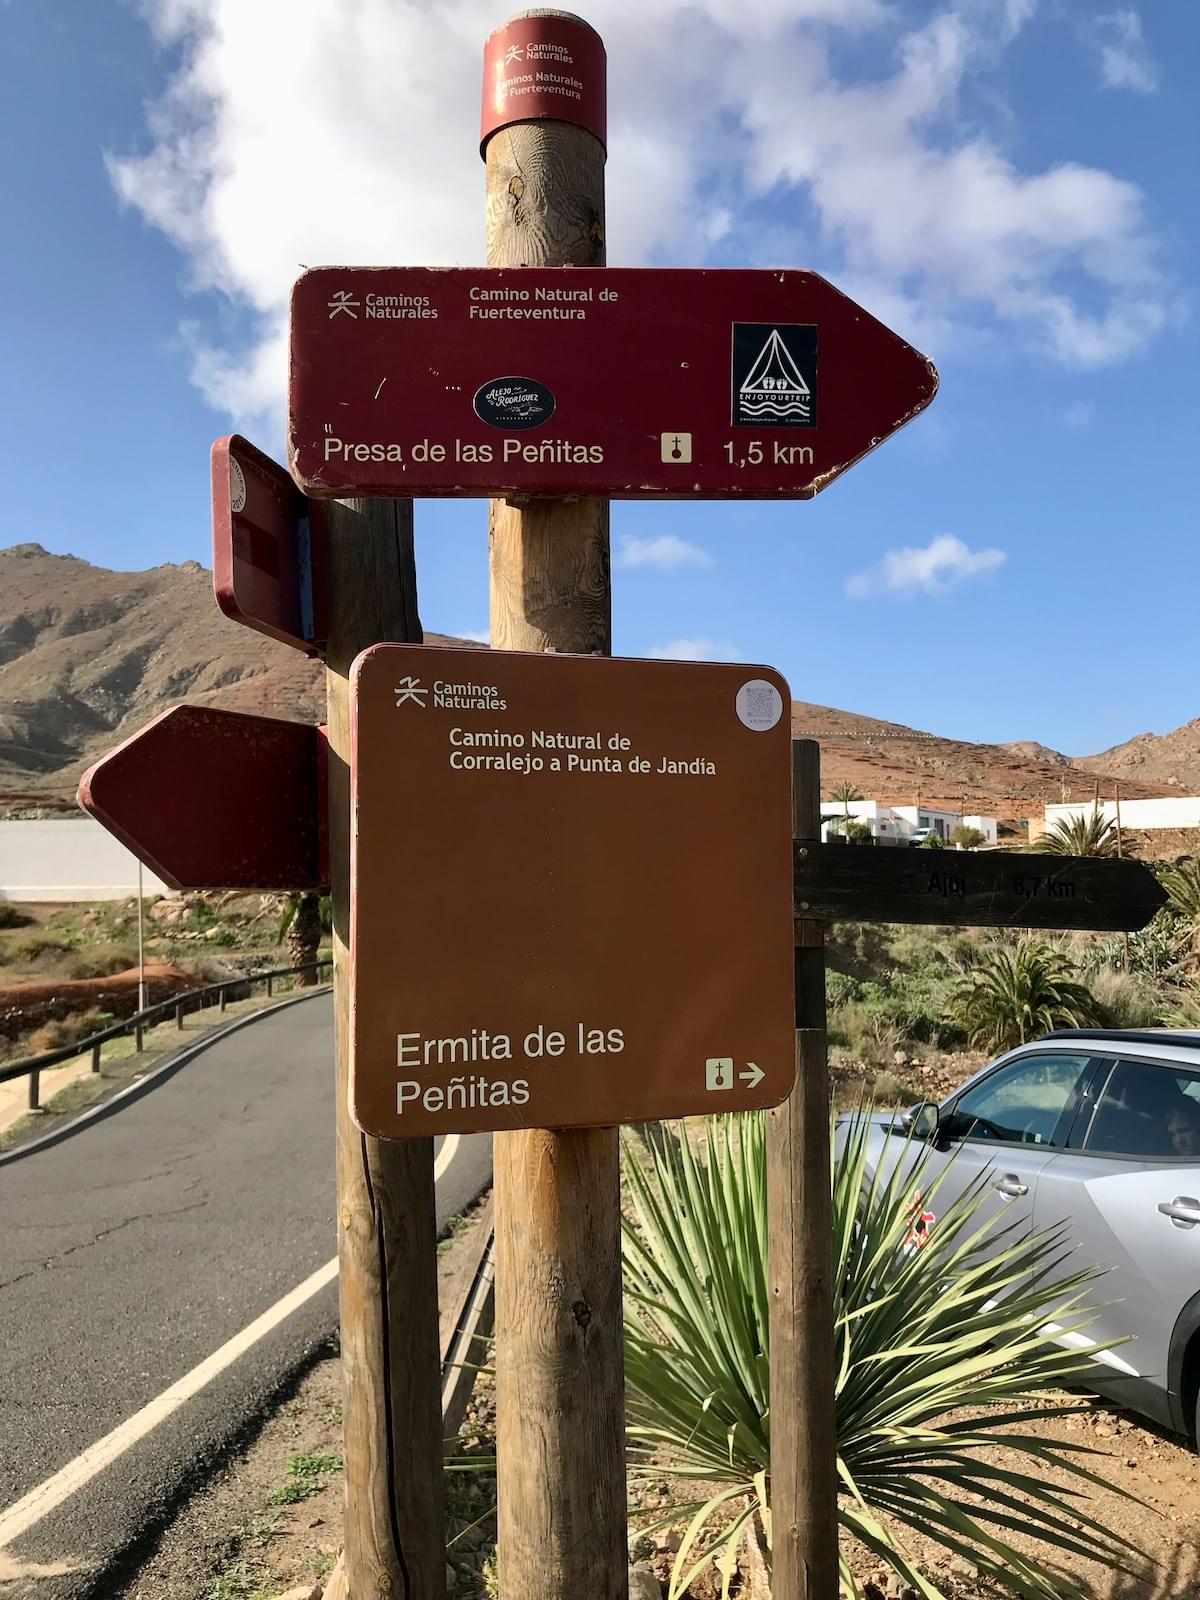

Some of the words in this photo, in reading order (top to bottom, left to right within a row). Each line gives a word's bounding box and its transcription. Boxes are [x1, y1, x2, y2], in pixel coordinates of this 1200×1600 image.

[526, 43, 568, 54] Caminos
[526, 52, 573, 64] Naturales
[536, 72, 583, 89] Naturales
[510, 85, 581, 100] Fuerteventura
[366, 293, 429, 306] Caminos
[470, 287, 529, 301] Camino
[535, 288, 593, 302] Natural
[599, 288, 618, 302] de
[366, 306, 438, 319] Naturales
[470, 306, 586, 320] Fuerteventura
[324, 438, 402, 462] Presa
[412, 439, 446, 462] de
[456, 439, 493, 463] las
[504, 438, 604, 464] Peñitas
[723, 440, 764, 468] 1,5
[774, 441, 814, 464] km
[433, 680, 498, 697] Caminos
[433, 694, 507, 710] Naturales
[449, 728, 525, 747] Camino
[532, 730, 601, 749] Natural
[608, 733, 631, 750] de
[449, 752, 543, 775] Corralejo
[550, 758, 561, 771] a
[568, 754, 622, 772] Punta
[628, 756, 651, 774] de
[657, 757, 716, 775] Jandía
[1015, 875, 1040, 900] 8,7
[1048, 877, 1075, 897] km
[396, 1029, 511, 1067] Ermita
[524, 1024, 565, 1056] de
[578, 1023, 625, 1054] las
[396, 1075, 530, 1114] Peñitas
